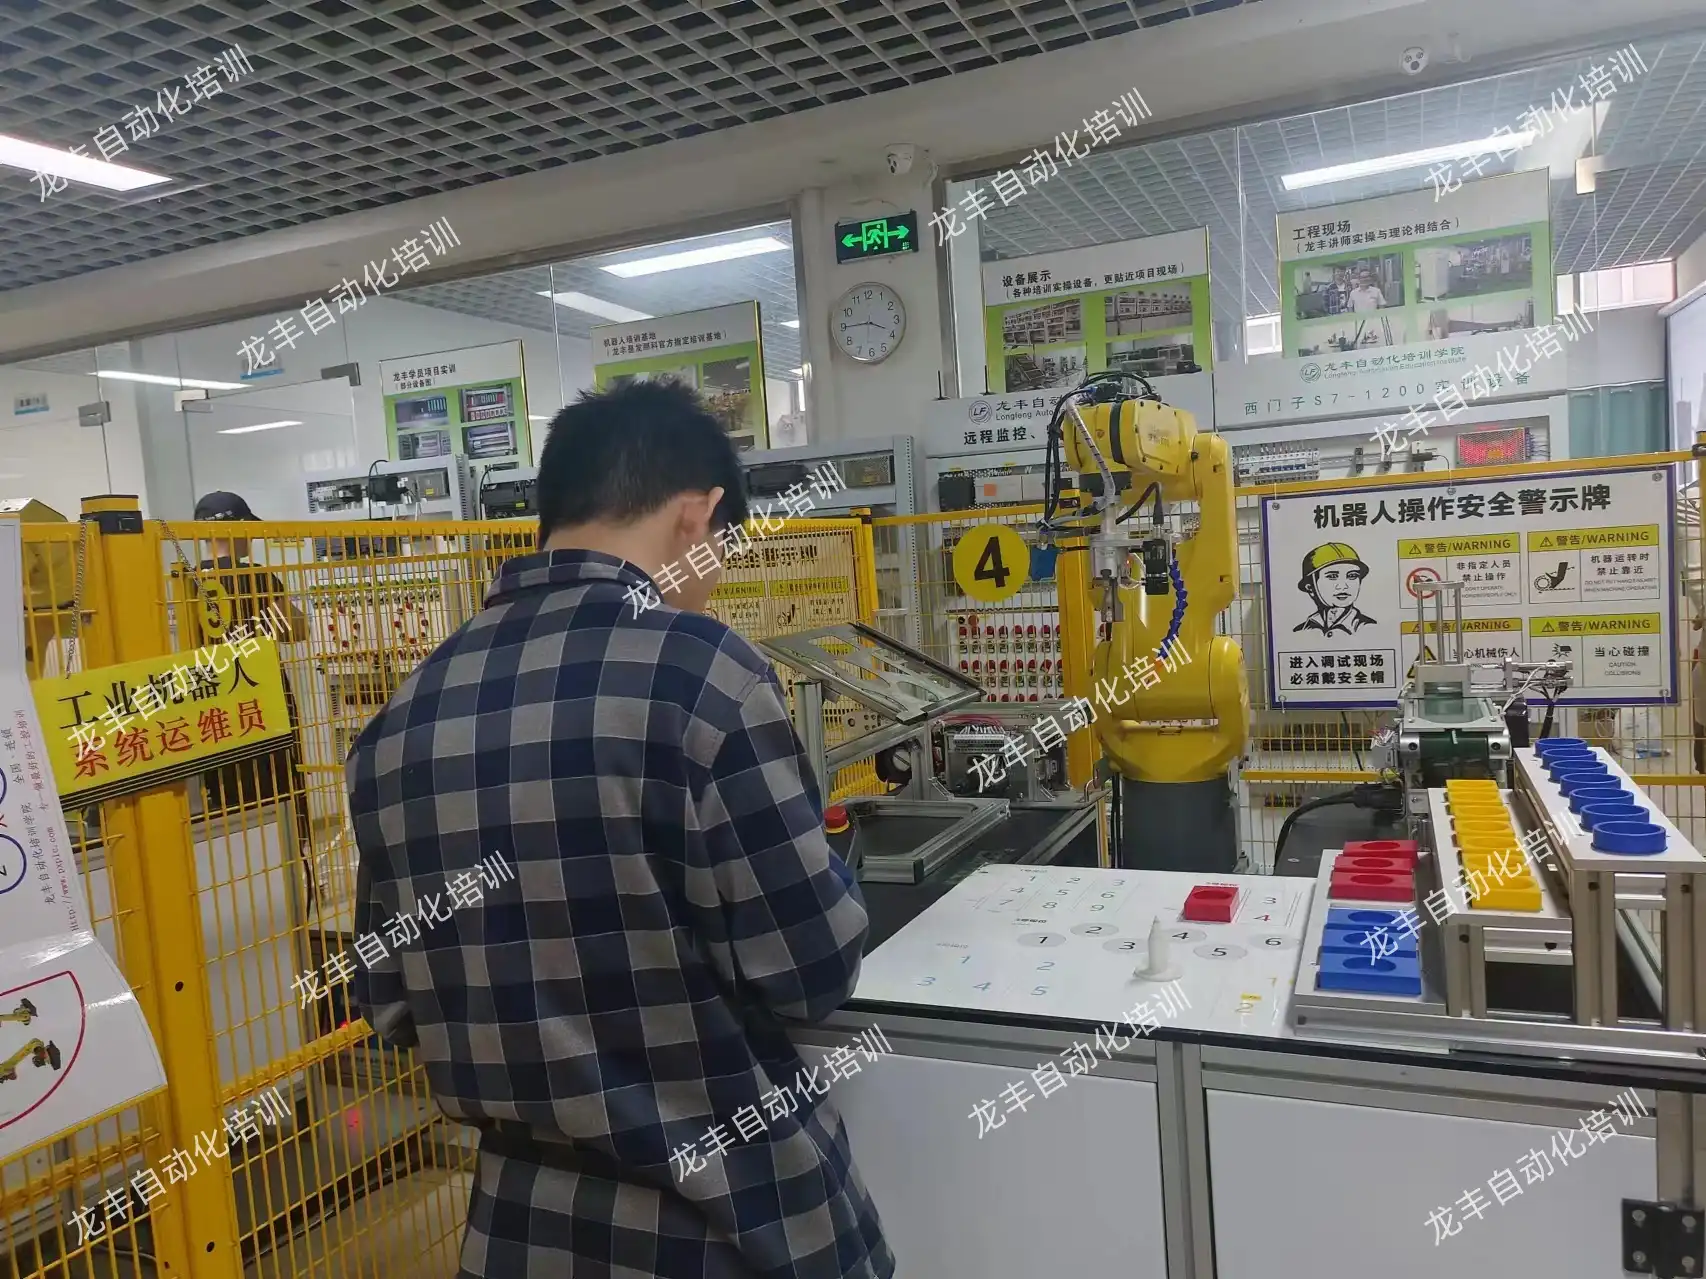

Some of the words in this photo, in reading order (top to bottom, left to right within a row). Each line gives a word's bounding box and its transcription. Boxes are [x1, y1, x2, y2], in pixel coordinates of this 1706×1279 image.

[1292, 220, 1351, 241] 工程现场
[1002, 270, 1051, 287] 设备展示
[852, 295, 860, 304] 11
[864, 290, 872, 299] 12
[888, 301, 894, 310] 2
[843, 308, 853, 317] 10
[894, 315, 900, 324] 3
[840, 323, 846, 331] 9
[603, 332, 657, 347] 机器人培训基地
[889, 331, 895, 339] 4
[847, 337, 853, 345] 8
[857, 346, 863, 355] 7
[868, 348, 875, 357] 6
[881, 343, 887, 352] 5
[1324, 346, 1465, 372] 龙丰自动化培训学院
[393, 363, 457, 382] 龙丰学员项目实训
[995, 411, 1032, 421] Longfeng
[963, 424, 1050, 445] 远程监控、
[1313, 483, 1612, 530] 机器人操作安全警示牌
[1556, 531, 1650, 546] 警告/WARNING
[1424, 539, 1511, 554] 警告/WARNING
[974, 536, 1010, 588] 4
[1590, 552, 1650, 564] 机器运转时
[1456, 560, 1511, 571] 非指定人员
[1597, 565, 1644, 576] 禁止靠近
[1462, 572, 1506, 582] 禁止操作
[1557, 619, 1651, 632] 警告/WARNING
[1594, 645, 1650, 657] 当心碰撞
[1289, 654, 1384, 669] 进入调试现场
[1290, 670, 1385, 685] 必须戴安全帽
[58, 656, 259, 730] 工业机器人
[70, 698, 266, 780] 系统运维员
[20, 802, 56, 905] 龙丰自动化培训学院
[1101, 891, 1115, 899] 6
[1262, 896, 1277, 904] 3
[1042, 901, 1058, 909] 8
[1085, 927, 1102, 935] 2
[1172, 932, 1189, 940] 4
[1118, 941, 1136, 950] 3
[1264, 937, 1282, 946] 6
[1211, 947, 1228, 957] 5
[1036, 961, 1056, 971] 2
[916, 976, 936, 987] 3
[972, 981, 992, 991] 4
[1030, 985, 1050, 996] 5
[1234, 1002, 1254, 1014] 2
